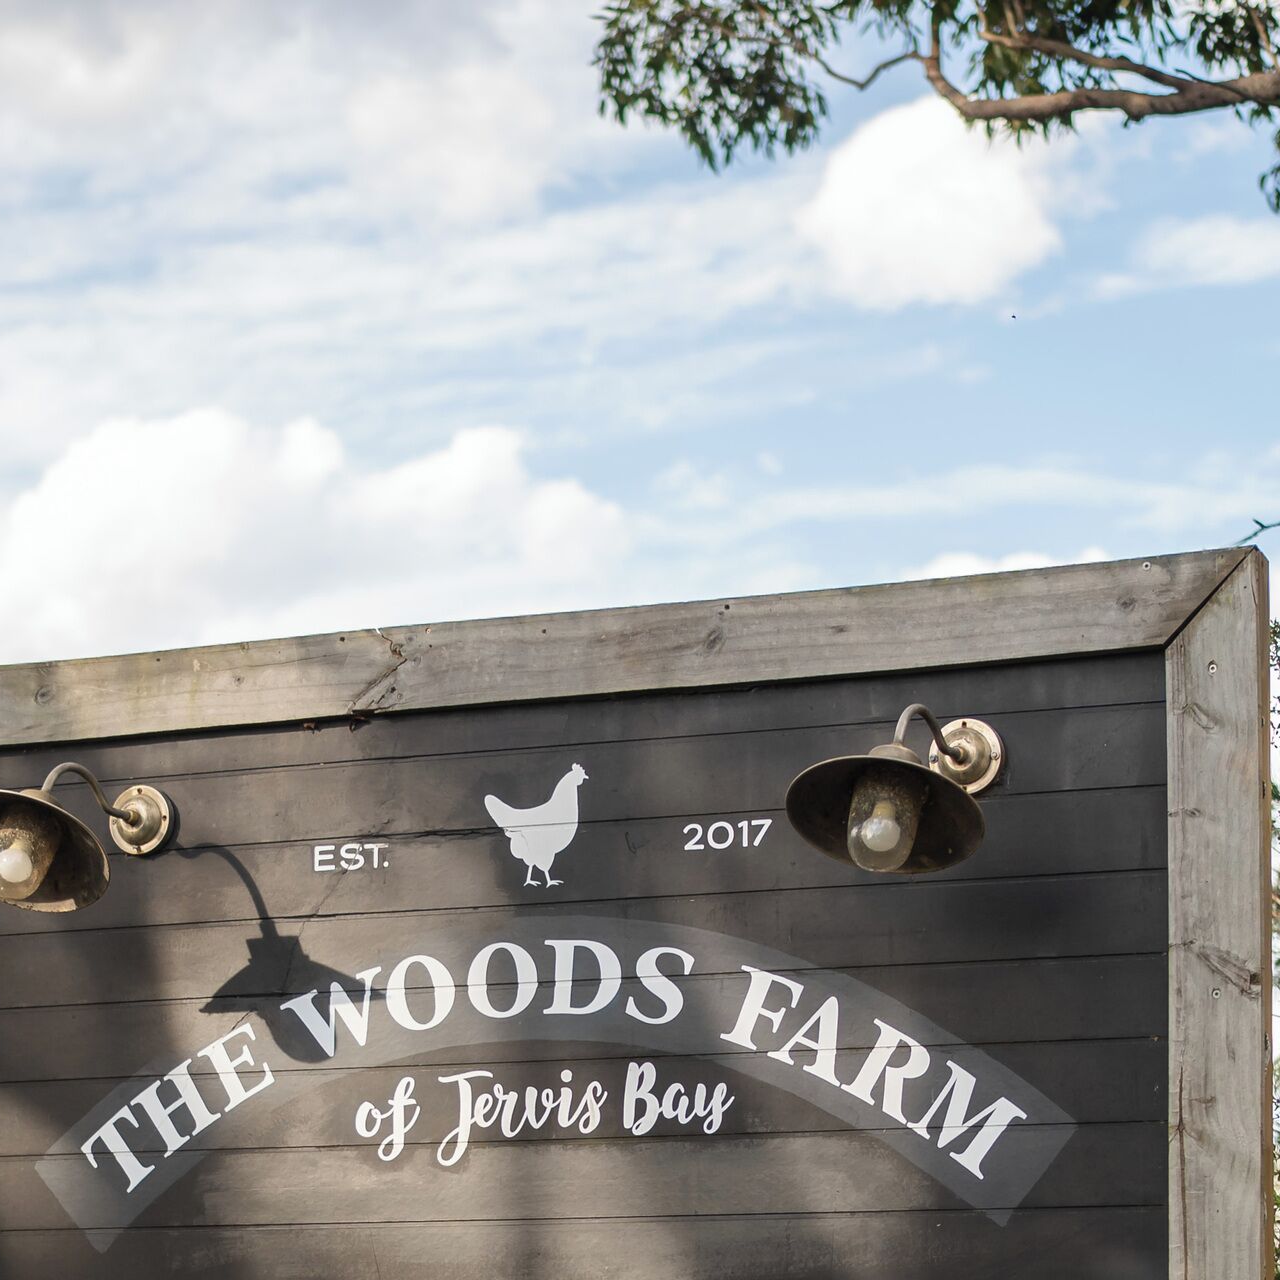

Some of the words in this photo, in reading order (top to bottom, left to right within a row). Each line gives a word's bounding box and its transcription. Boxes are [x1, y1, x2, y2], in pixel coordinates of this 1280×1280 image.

[312, 842, 390, 872] EST.
[682, 818, 774, 851] 2017
[80, 1022, 276, 1194] THE
[279, 939, 696, 1058] WOODS
[720, 964, 1028, 1181] FARM
[354, 1076, 421, 1163] of
[436, 1069, 608, 1167] Jervis
[622, 1061, 736, 1136] Bay
